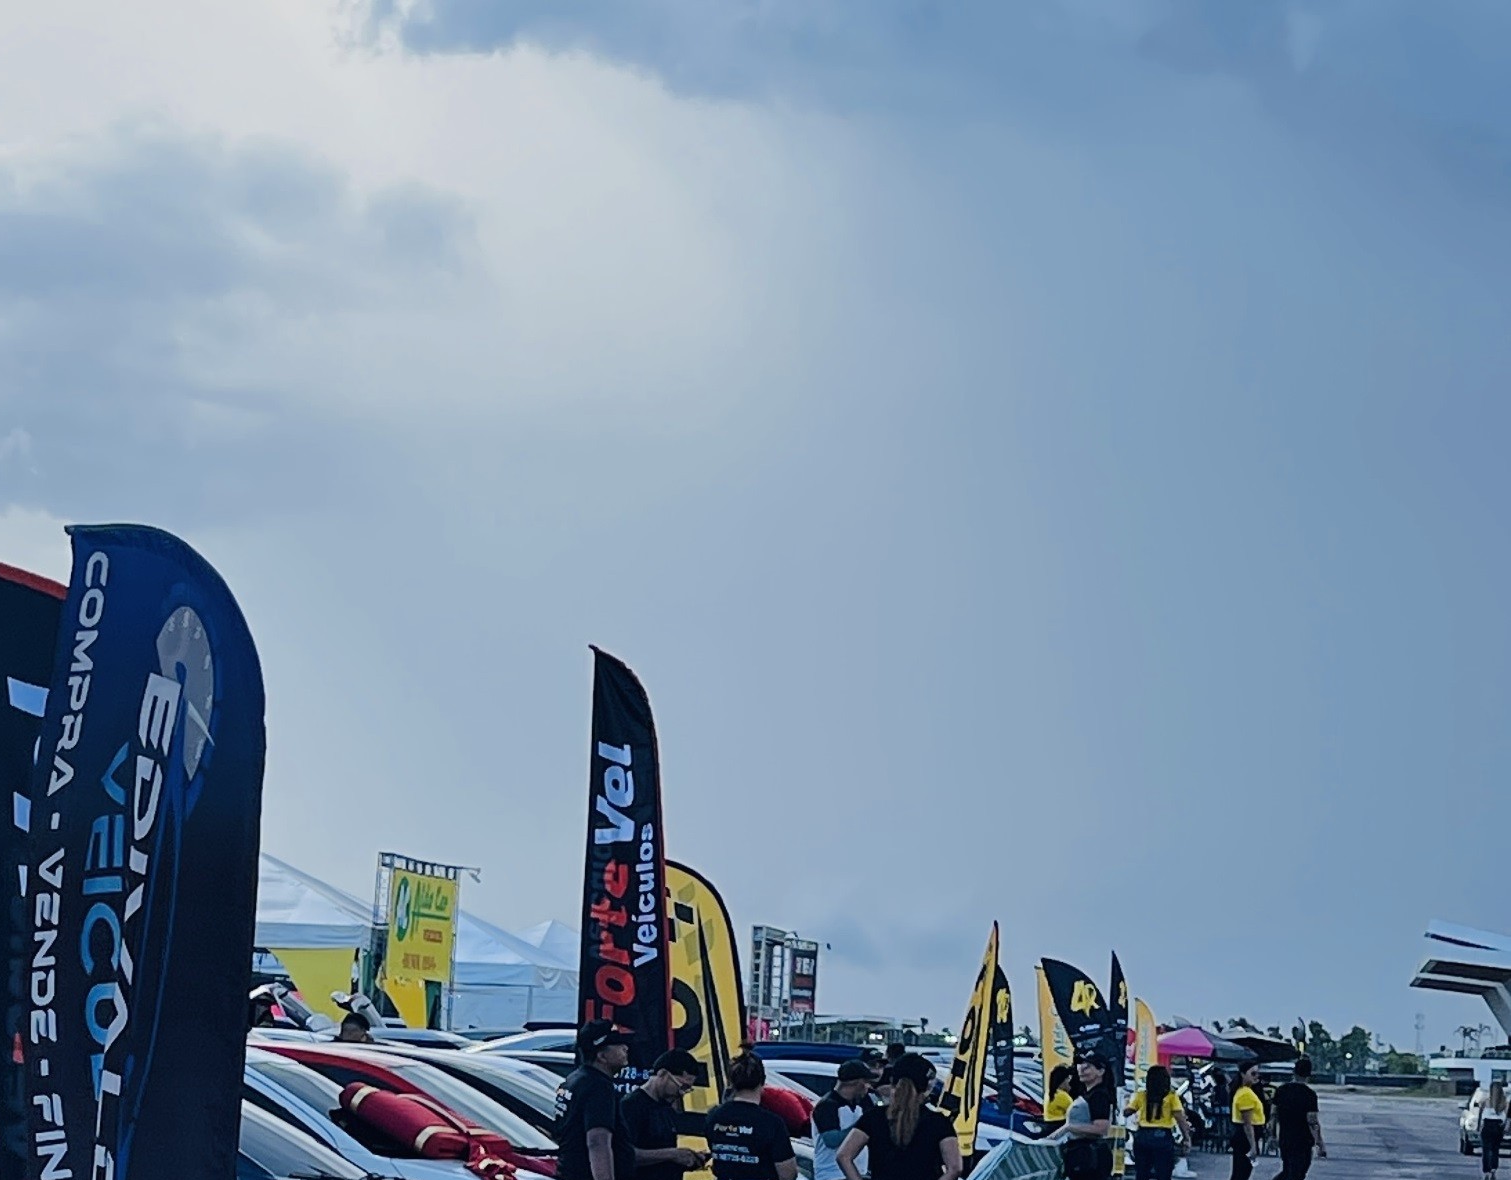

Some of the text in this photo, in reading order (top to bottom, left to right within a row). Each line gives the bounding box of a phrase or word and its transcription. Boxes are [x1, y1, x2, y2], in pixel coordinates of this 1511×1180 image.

[47, 551, 109, 797] COMPRA
[594, 740, 635, 844] Vel
[30, 848, 65, 1044] VENDE
[632, 822, 658, 968] Veículos
